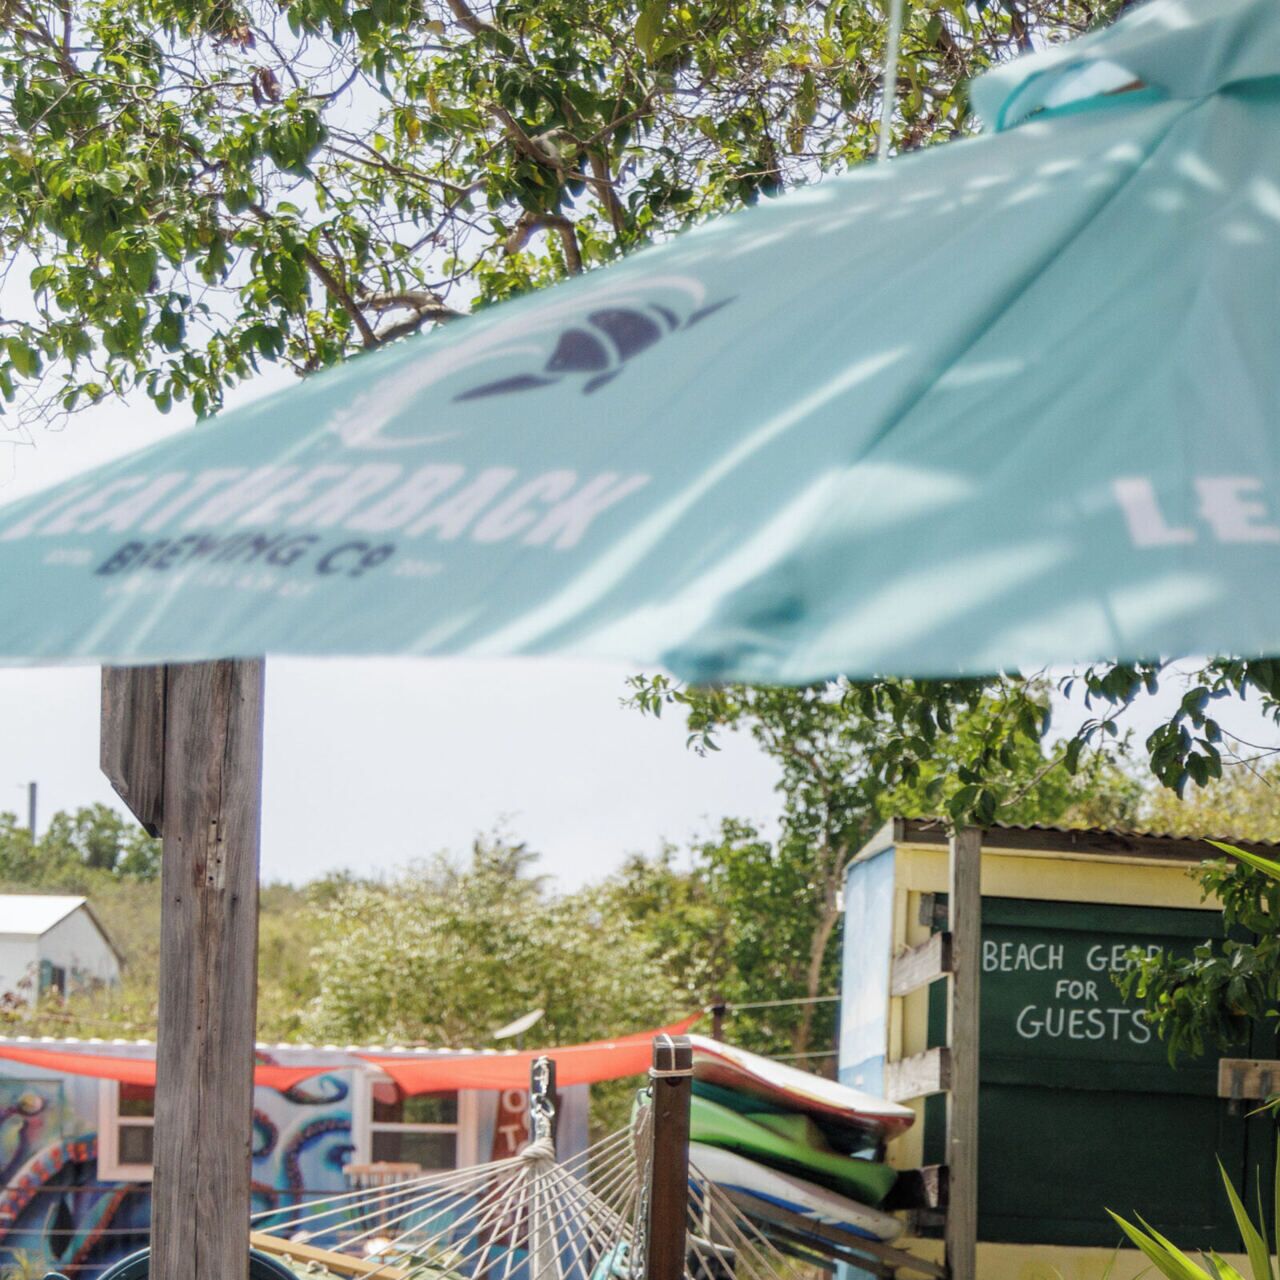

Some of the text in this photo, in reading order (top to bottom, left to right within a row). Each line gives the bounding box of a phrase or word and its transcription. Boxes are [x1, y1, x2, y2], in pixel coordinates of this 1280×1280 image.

[96, 533, 318, 577] BREWING
[982, 940, 1064, 972] BEACH
[1055, 979, 1099, 1001] FOR
[1016, 1005, 1151, 1044] GUESTS
